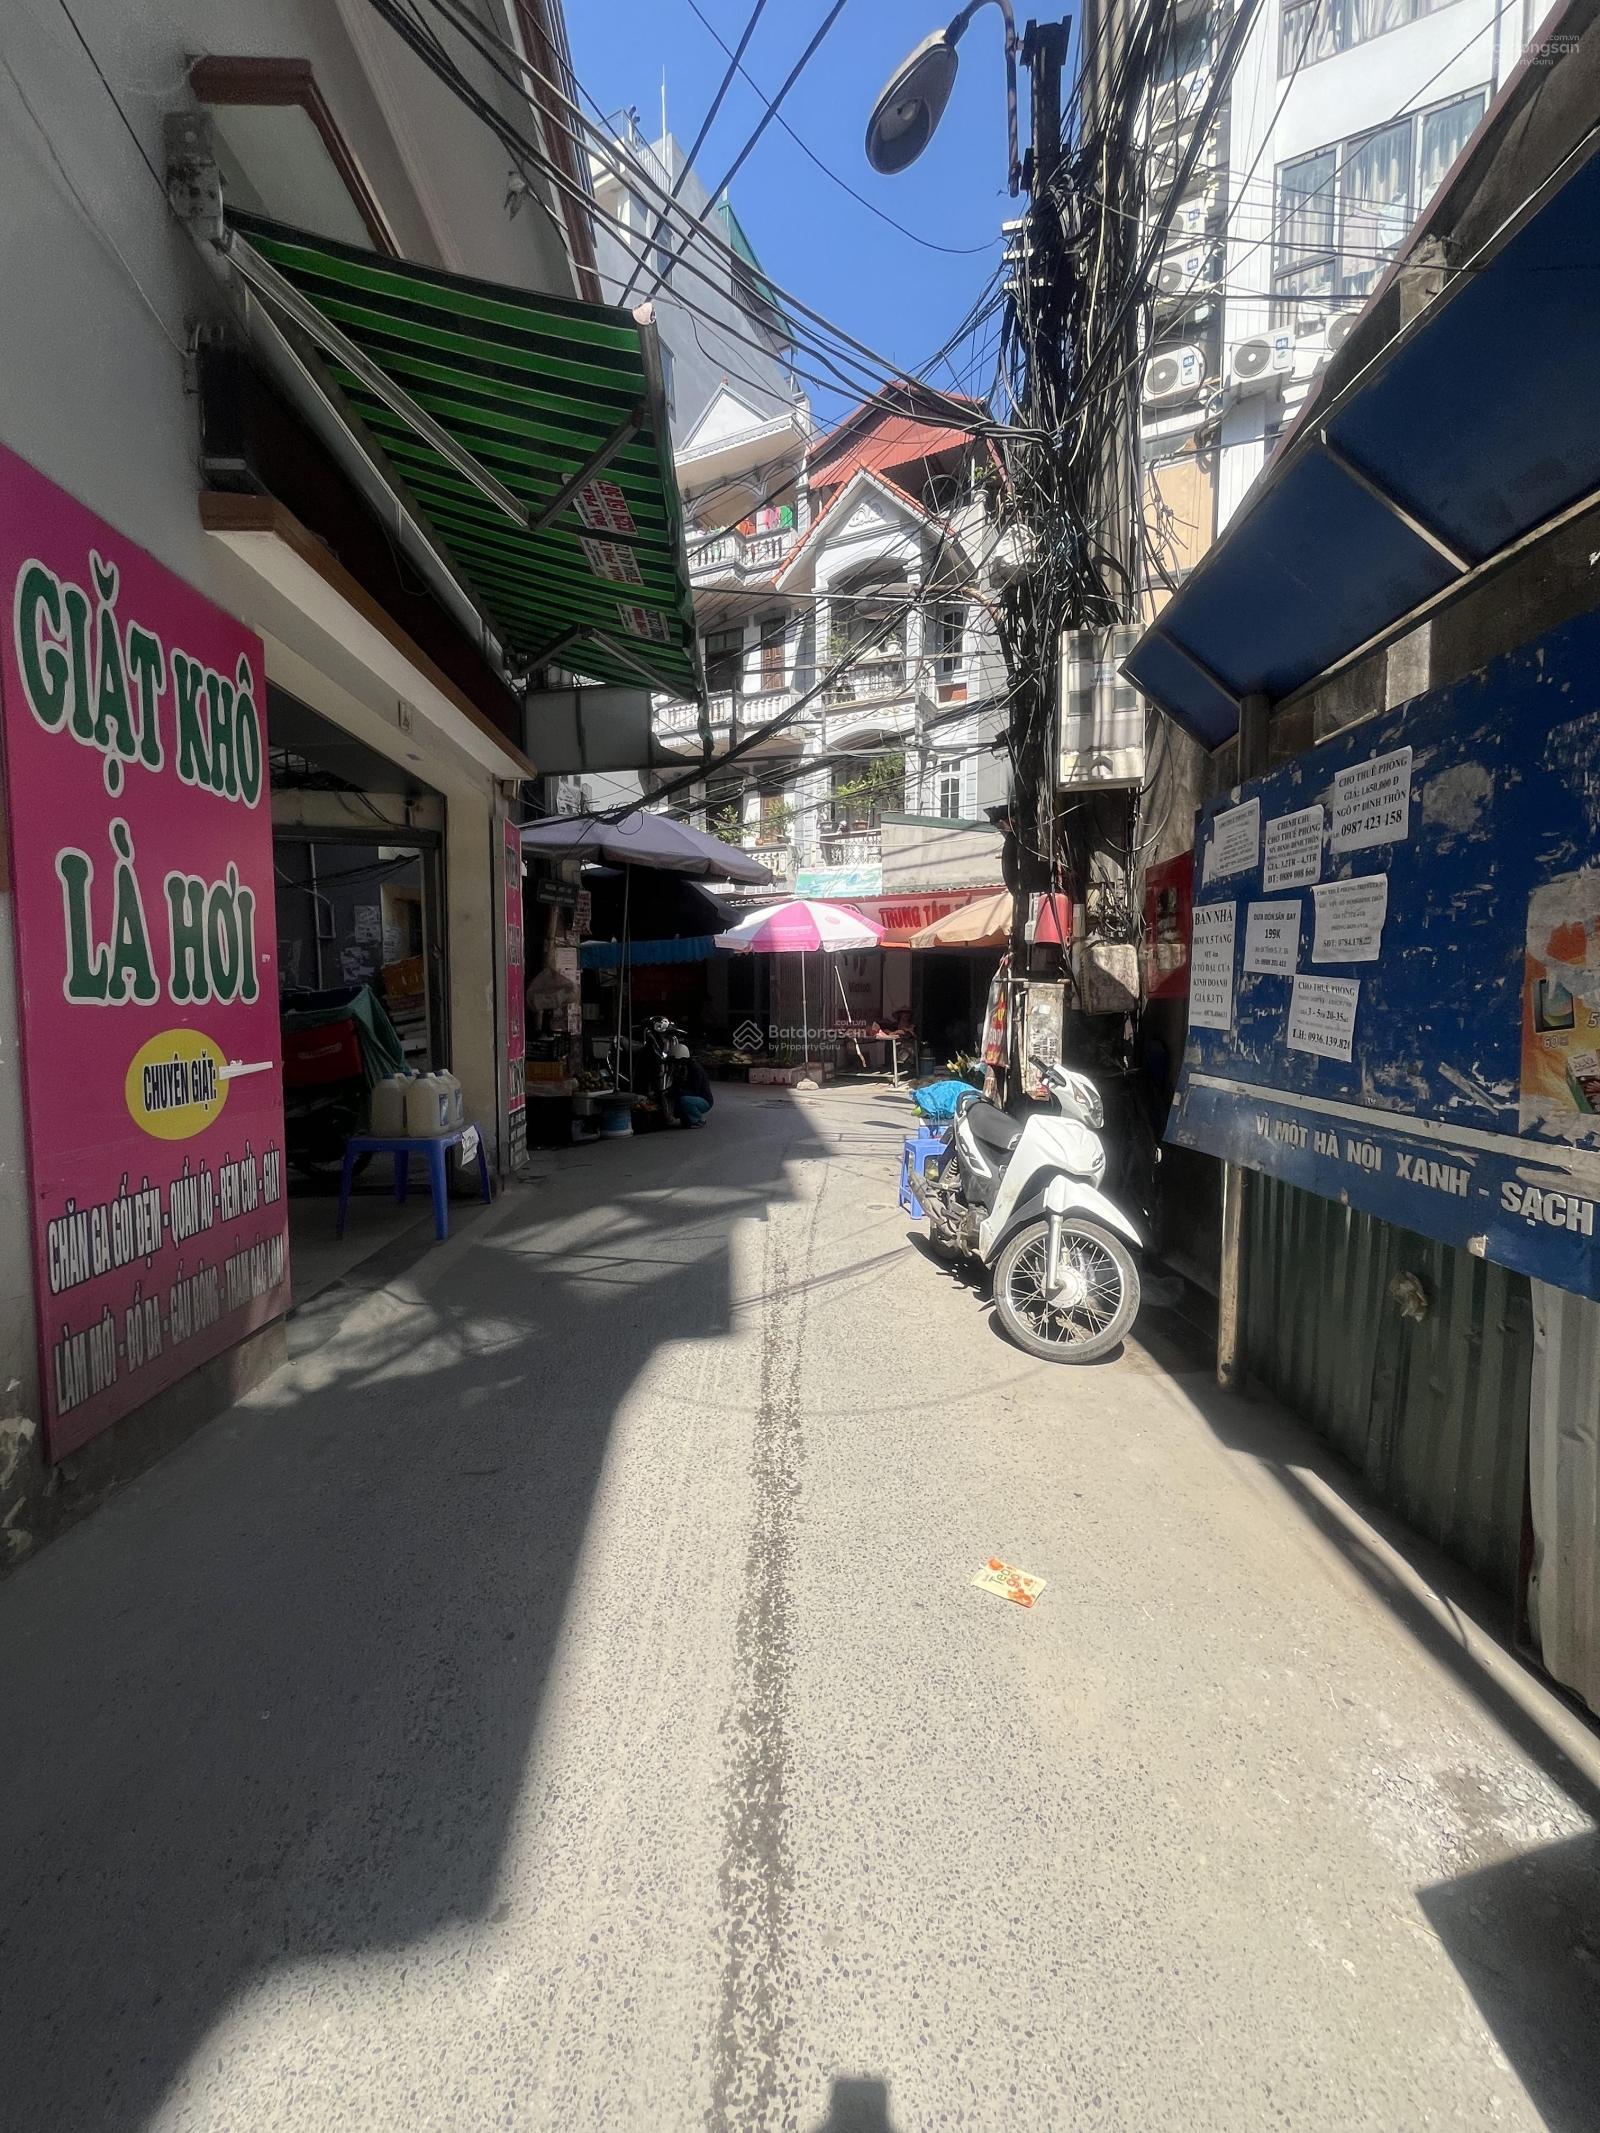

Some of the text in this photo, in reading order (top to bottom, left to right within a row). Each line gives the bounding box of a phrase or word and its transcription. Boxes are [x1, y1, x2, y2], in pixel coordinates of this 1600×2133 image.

[14, 549, 262, 808] GIẶT KHÔ
[1339, 775, 1355, 788] CHO
[1357, 764, 1376, 781] THUÊ
[1384, 789, 1407, 805] THÔN
[1341, 819, 1363, 837] 0987
[1364, 815, 1381, 831] 423
[1385, 809, 1403, 826] 158
[55, 817, 260, 1006] LÀ HƠI
[878, 905, 921, 929] TRUNG
[1213, 905, 1233, 925] NHÀ
[1264, 928, 1281, 940] 199K
[143, 1049, 218, 1111] CHUYÊN GIẶT:
[1255, 1111, 1270, 1138] VÌ
[1275, 1119, 1308, 1150] MỘT
[1314, 1129, 1340, 1159] HÀ
[1347, 1133, 1382, 1174] NỘI
[1396, 1152, 1471, 1197] XANH
[1500, 1181, 1594, 1237] SẠCH
[47, 1198, 90, 1295] CHĂN
[91, 1204, 110, 1277] GA
[112, 1172, 135, 1268] GỐI
[135, 1177, 163, 1269] ĐỆM
[170, 1156, 198, 1250] QUẦN
[200, 1160, 213, 1230] ÁO
[219, 1153, 240, 1222] RÈM
[241, 1140, 257, 1214] CỬA
[263, 1140, 281, 1205] GIÀY
[54, 1325, 89, 1415] LÀM
[90, 1304, 117, 1394] MỚI
[144, 1295, 163, 1361] DA
[170, 1259, 191, 1345] GẤU
[192, 1258, 219, 1332] BÔNG
